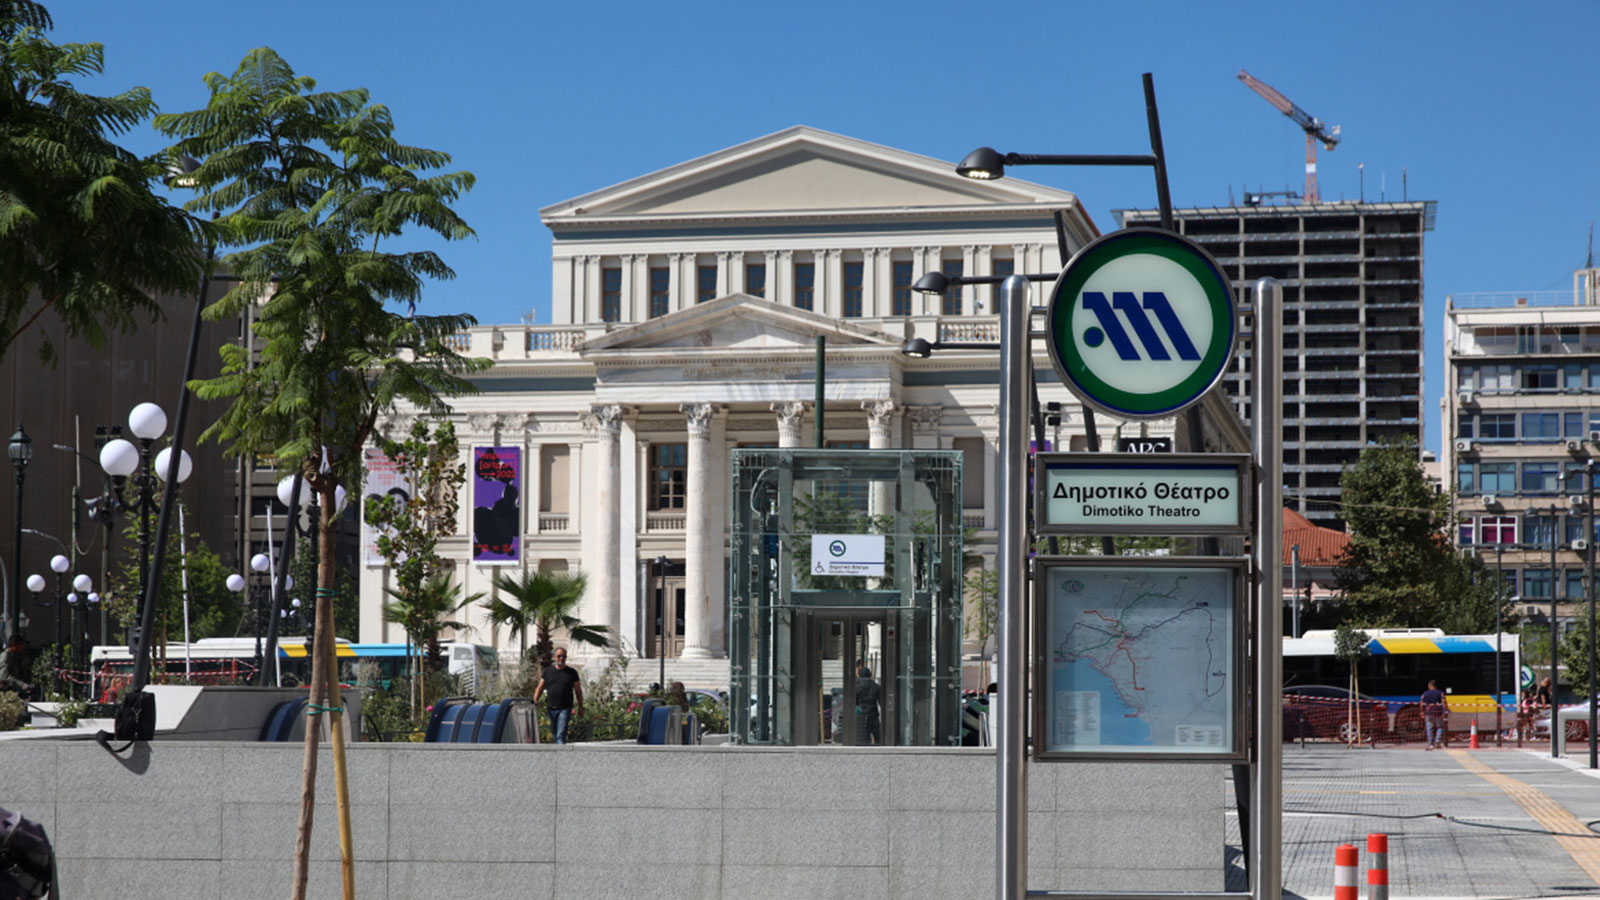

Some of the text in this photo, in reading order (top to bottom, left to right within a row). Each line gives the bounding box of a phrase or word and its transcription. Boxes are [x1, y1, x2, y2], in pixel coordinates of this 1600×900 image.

[1053, 482, 1230, 503] Δημοτικό Θέατρο
[1083, 505, 1200, 517] Dimotiko Theatro
